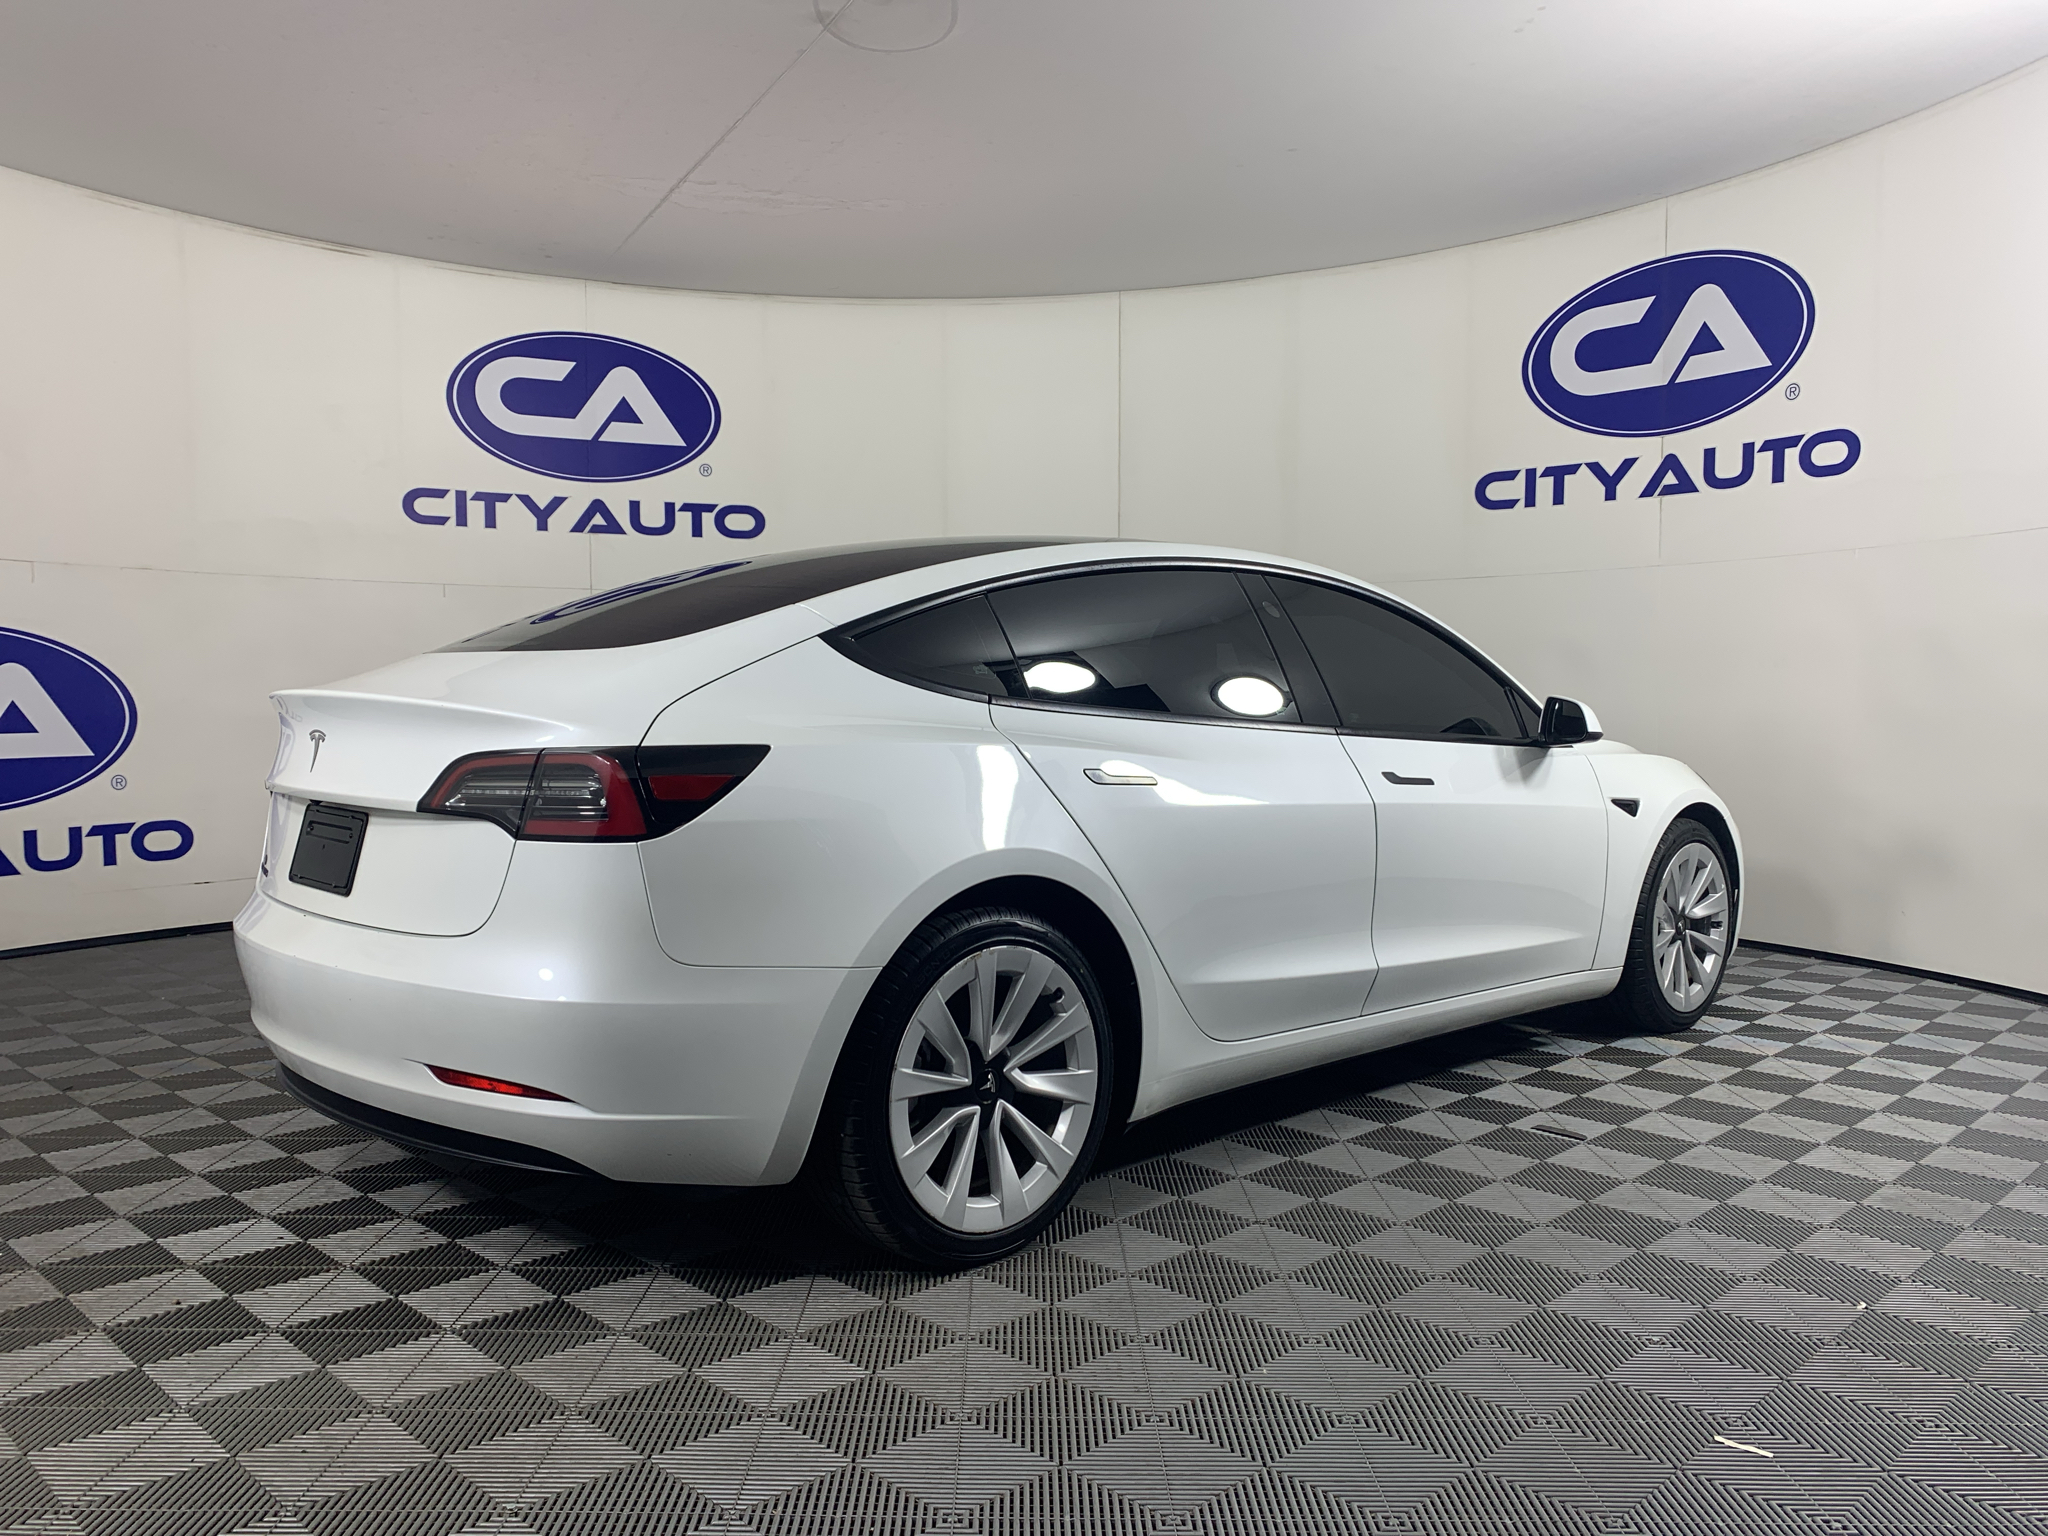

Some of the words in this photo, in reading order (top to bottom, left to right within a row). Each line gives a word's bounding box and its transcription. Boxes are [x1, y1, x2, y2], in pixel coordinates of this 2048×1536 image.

[1550, 283, 1772, 396] CA
[474, 356, 687, 446] CA
[0, 662, 95, 760] A
